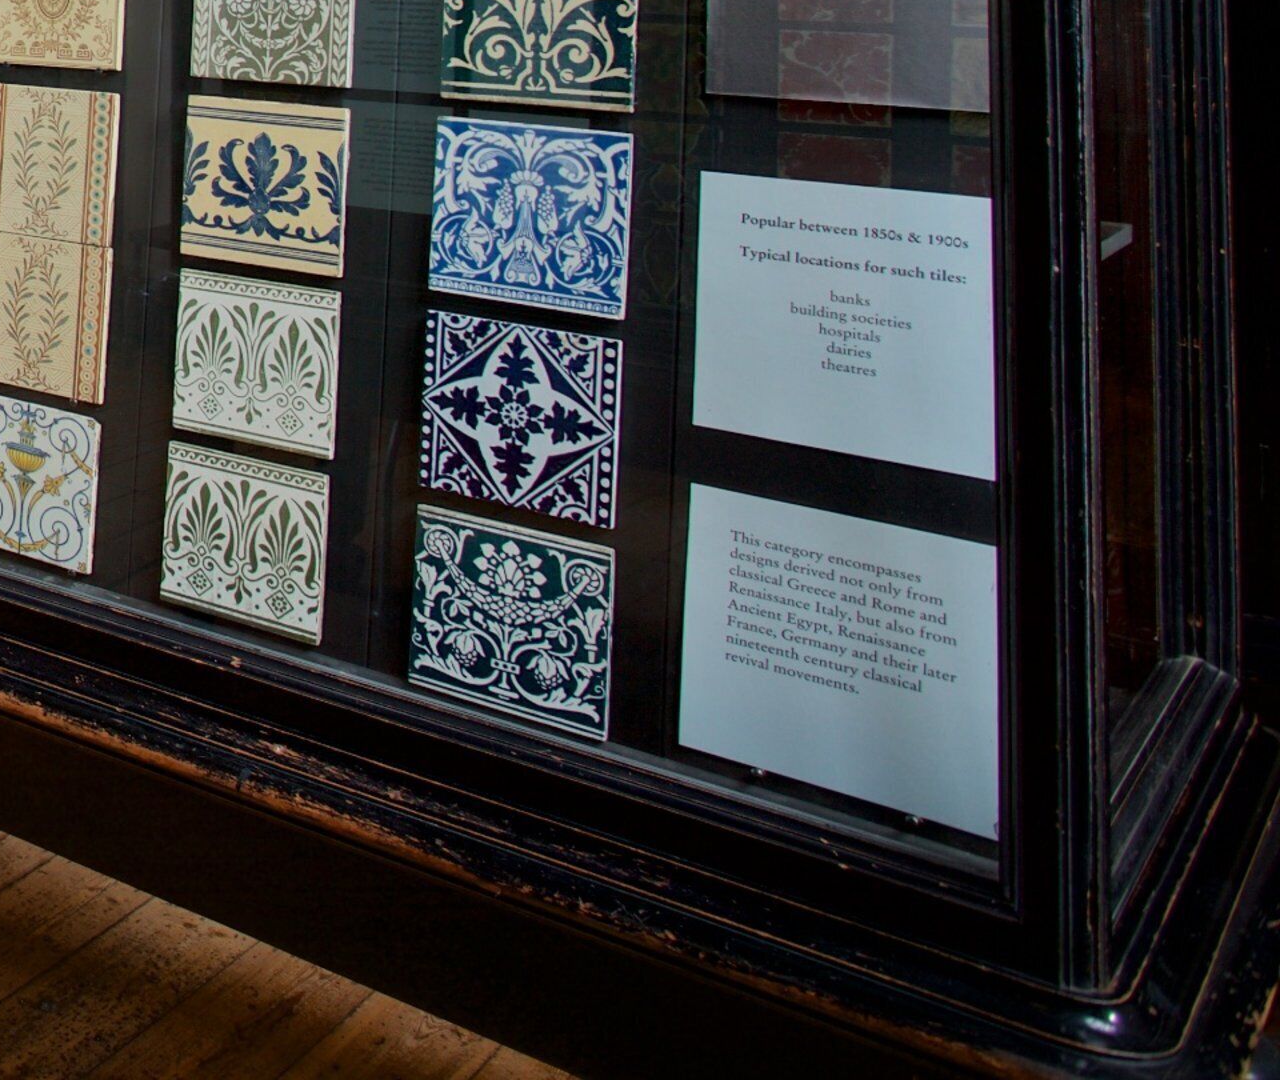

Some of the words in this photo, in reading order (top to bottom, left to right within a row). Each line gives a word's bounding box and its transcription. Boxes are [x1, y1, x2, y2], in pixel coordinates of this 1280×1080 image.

[742, 213, 794, 230] Popular
[800, 220, 858, 236] between
[864, 226, 902, 242] 1850s
[908, 232, 920, 243] &
[928, 234, 969, 249] 1900s
[741, 246, 790, 262] Typical
[796, 251, 860, 271] locations
[864, 260, 887, 274] for
[891, 263, 924, 279] such
[930, 268, 966, 284] tiles:
[791, 302, 847, 323] building
[851, 312, 912, 330] societies
[830, 290, 870, 306] banks
[819, 324, 881, 343] hospitals
[827, 342, 872, 359] dairies
[821, 358, 876, 377] theatres
[730, 548, 779, 569] designs
[784, 560, 834, 581] derived
[840, 574, 863, 588] not
[869, 580, 901, 599] only
[906, 586, 944, 606] from
[731, 529, 760, 547] This
[764, 540, 823, 562] category
[828, 554, 921, 583] encompasses
[729, 566, 782, 586] classical
[788, 578, 836, 599] Greece
[840, 592, 866, 606] and
[872, 596, 916, 618] Rome
[920, 611, 948, 625] and
[729, 581, 810, 610] Renaissance
[816, 602, 852, 622] Italy,
[856, 612, 880, 627] but
[886, 620, 914, 636] also
[920, 627, 958, 646] from
[728, 599, 781, 620] Ancient
[788, 612, 832, 635] Egypt,
[839, 626, 926, 656] Renaissance
[726, 634, 799, 660] nineteenth
[804, 652, 858, 678] century
[863, 669, 922, 692] classical
[727, 616, 777, 639] France,
[781, 628, 847, 656] Germany
[852, 648, 878, 663] and
[882, 656, 918, 674] their
[923, 663, 958, 683] later
[726, 652, 769, 671] revival
[774, 663, 860, 694] movements.
